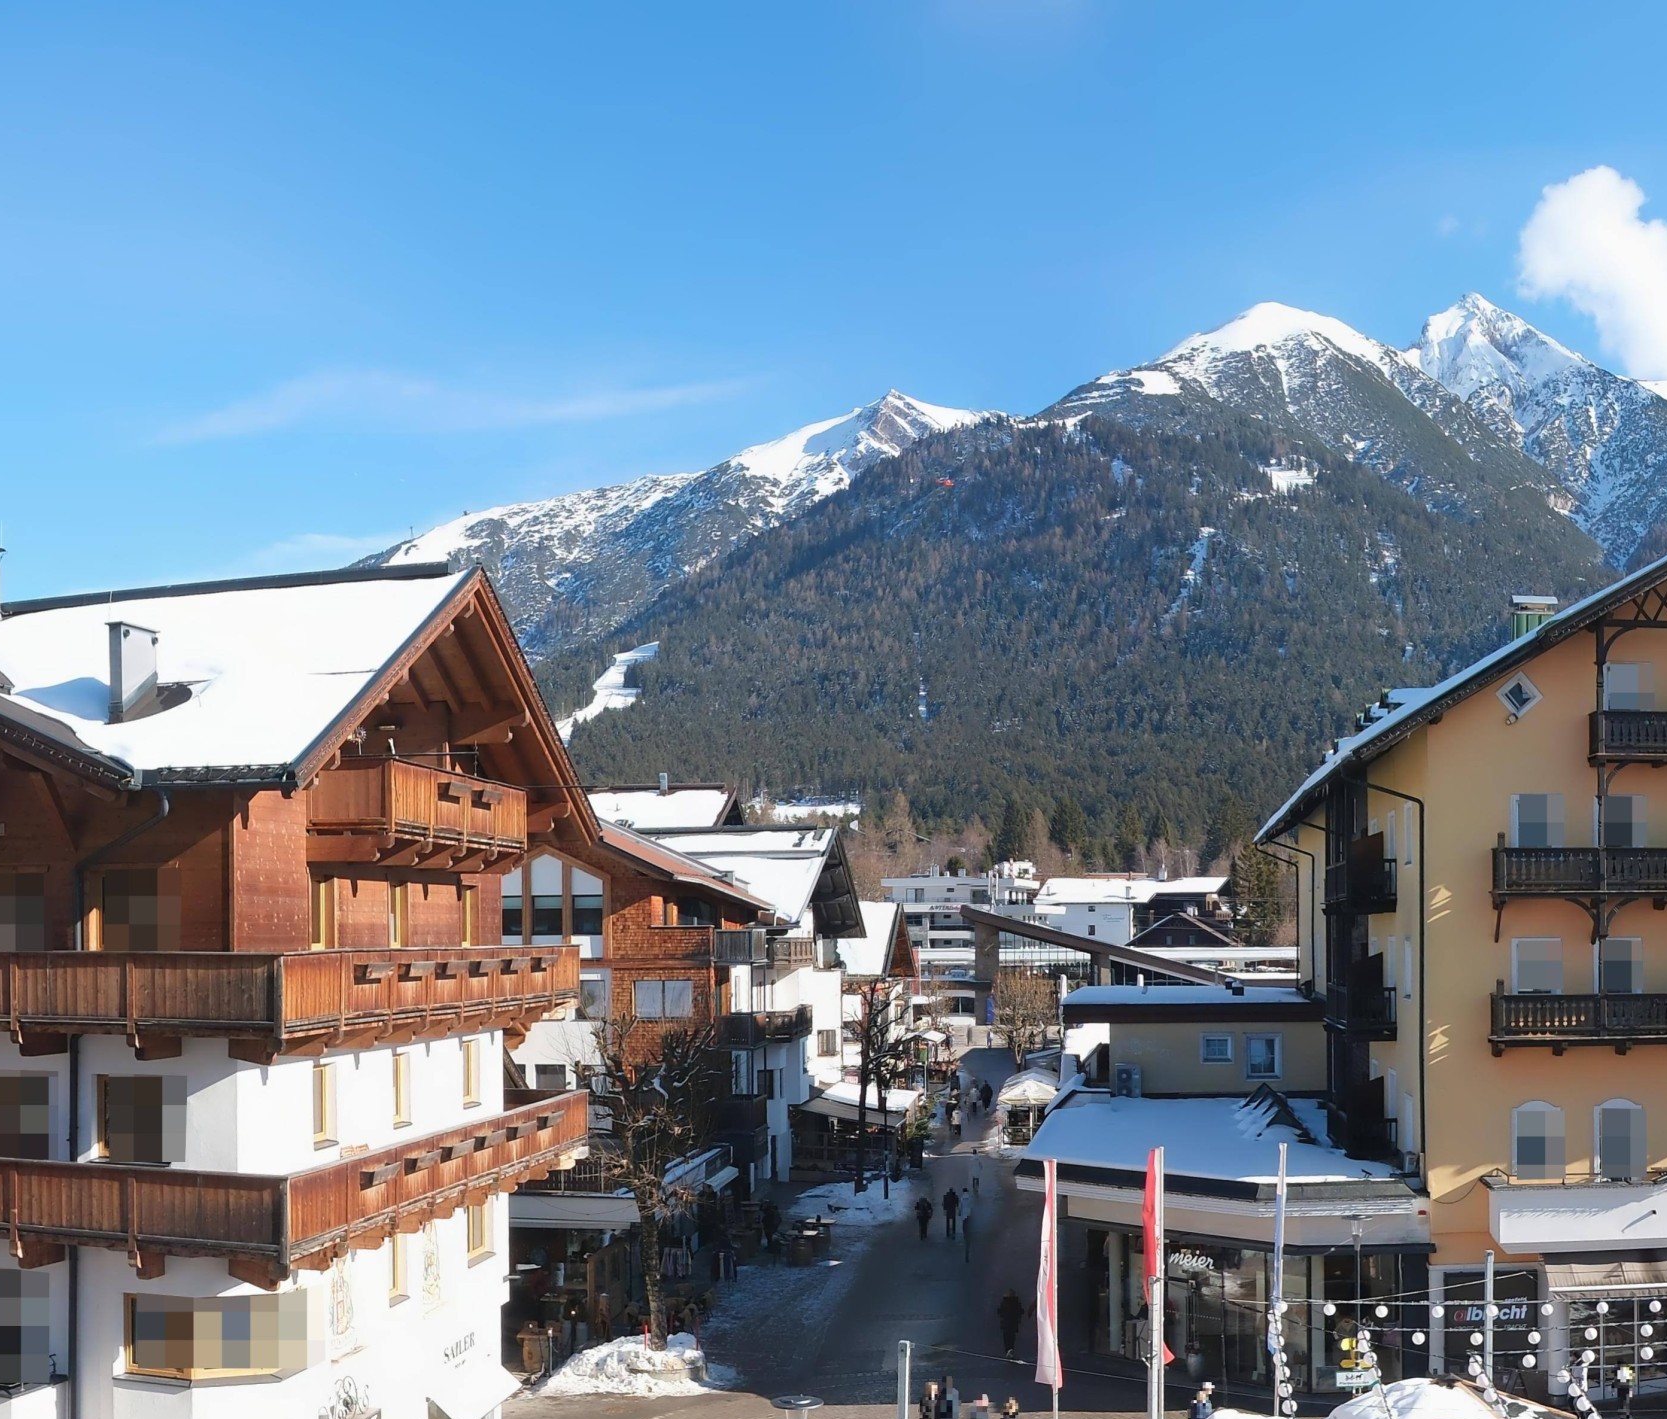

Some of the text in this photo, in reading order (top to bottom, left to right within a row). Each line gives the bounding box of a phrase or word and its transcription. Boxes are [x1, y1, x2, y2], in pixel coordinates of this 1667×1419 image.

[1169, 1250, 1214, 1270] meier
[1454, 1304, 1528, 1322] albcht
[443, 1331, 475, 1362] SAILER
